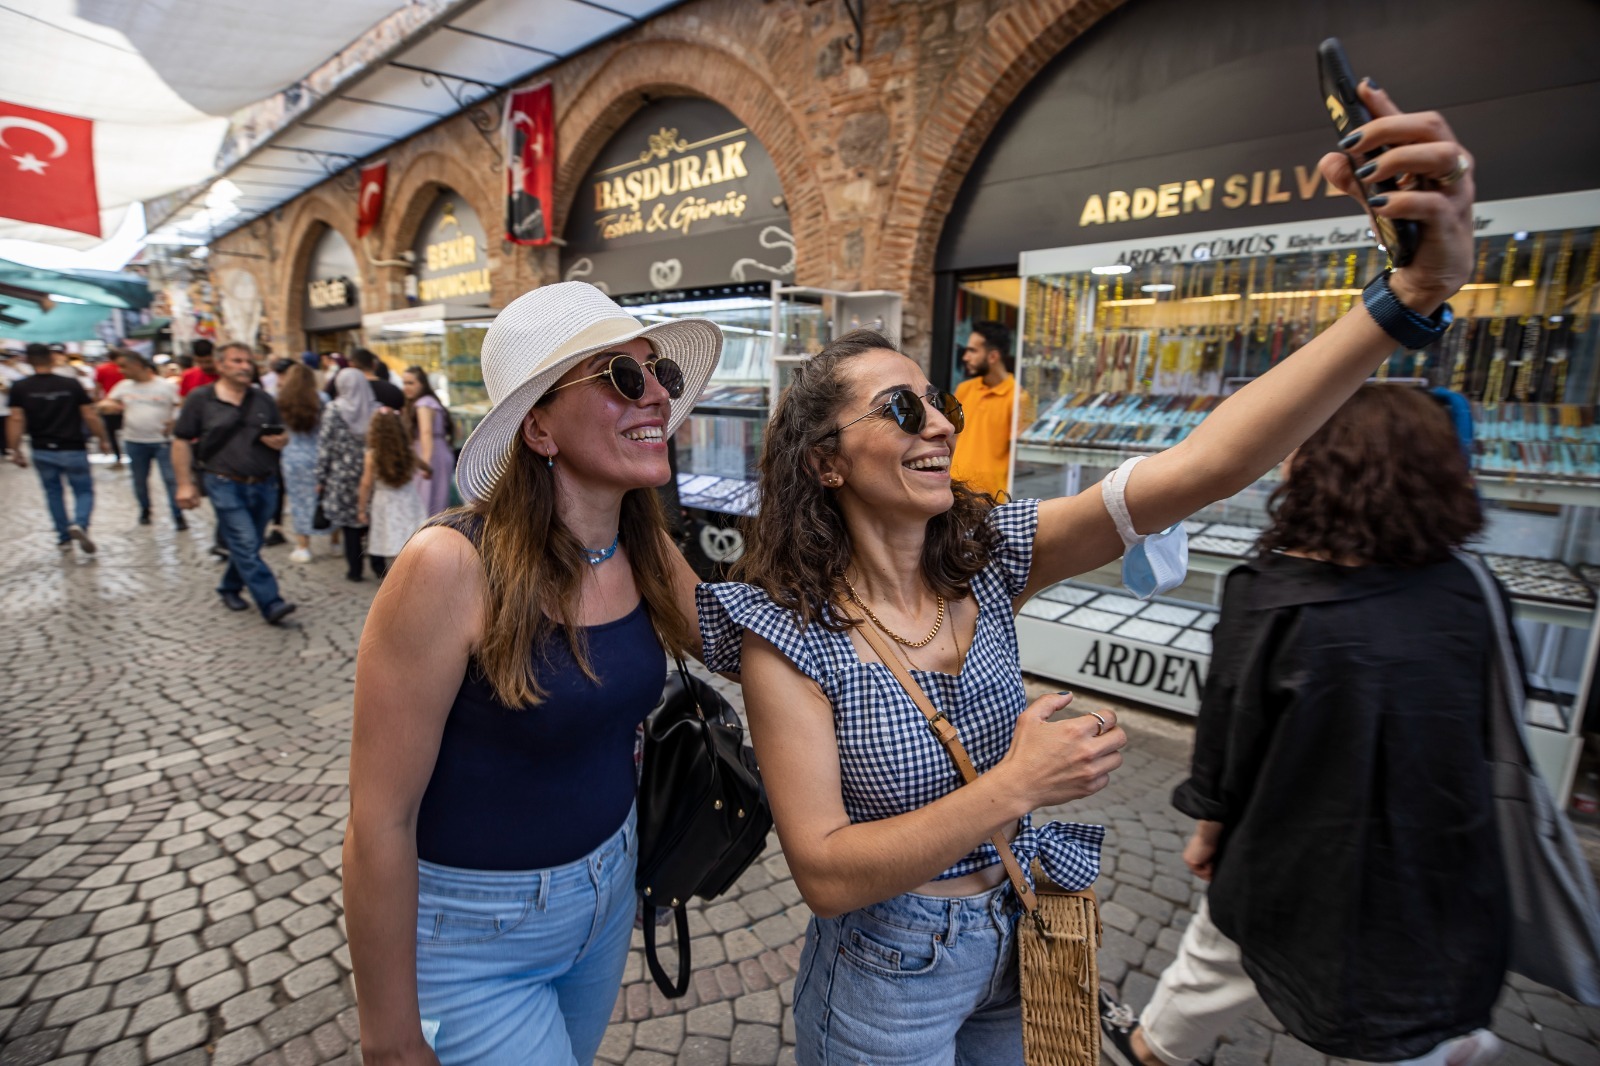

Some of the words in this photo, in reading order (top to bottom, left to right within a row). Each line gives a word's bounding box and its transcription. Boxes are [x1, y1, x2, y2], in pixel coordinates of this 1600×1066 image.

[594, 141, 748, 212] BAŞDURAK
[645, 202, 669, 233] &
[1079, 178, 1214, 227] ARDEN
[1114, 243, 1187, 266] ARDEN
[1078, 639, 1202, 702] ARDEN
